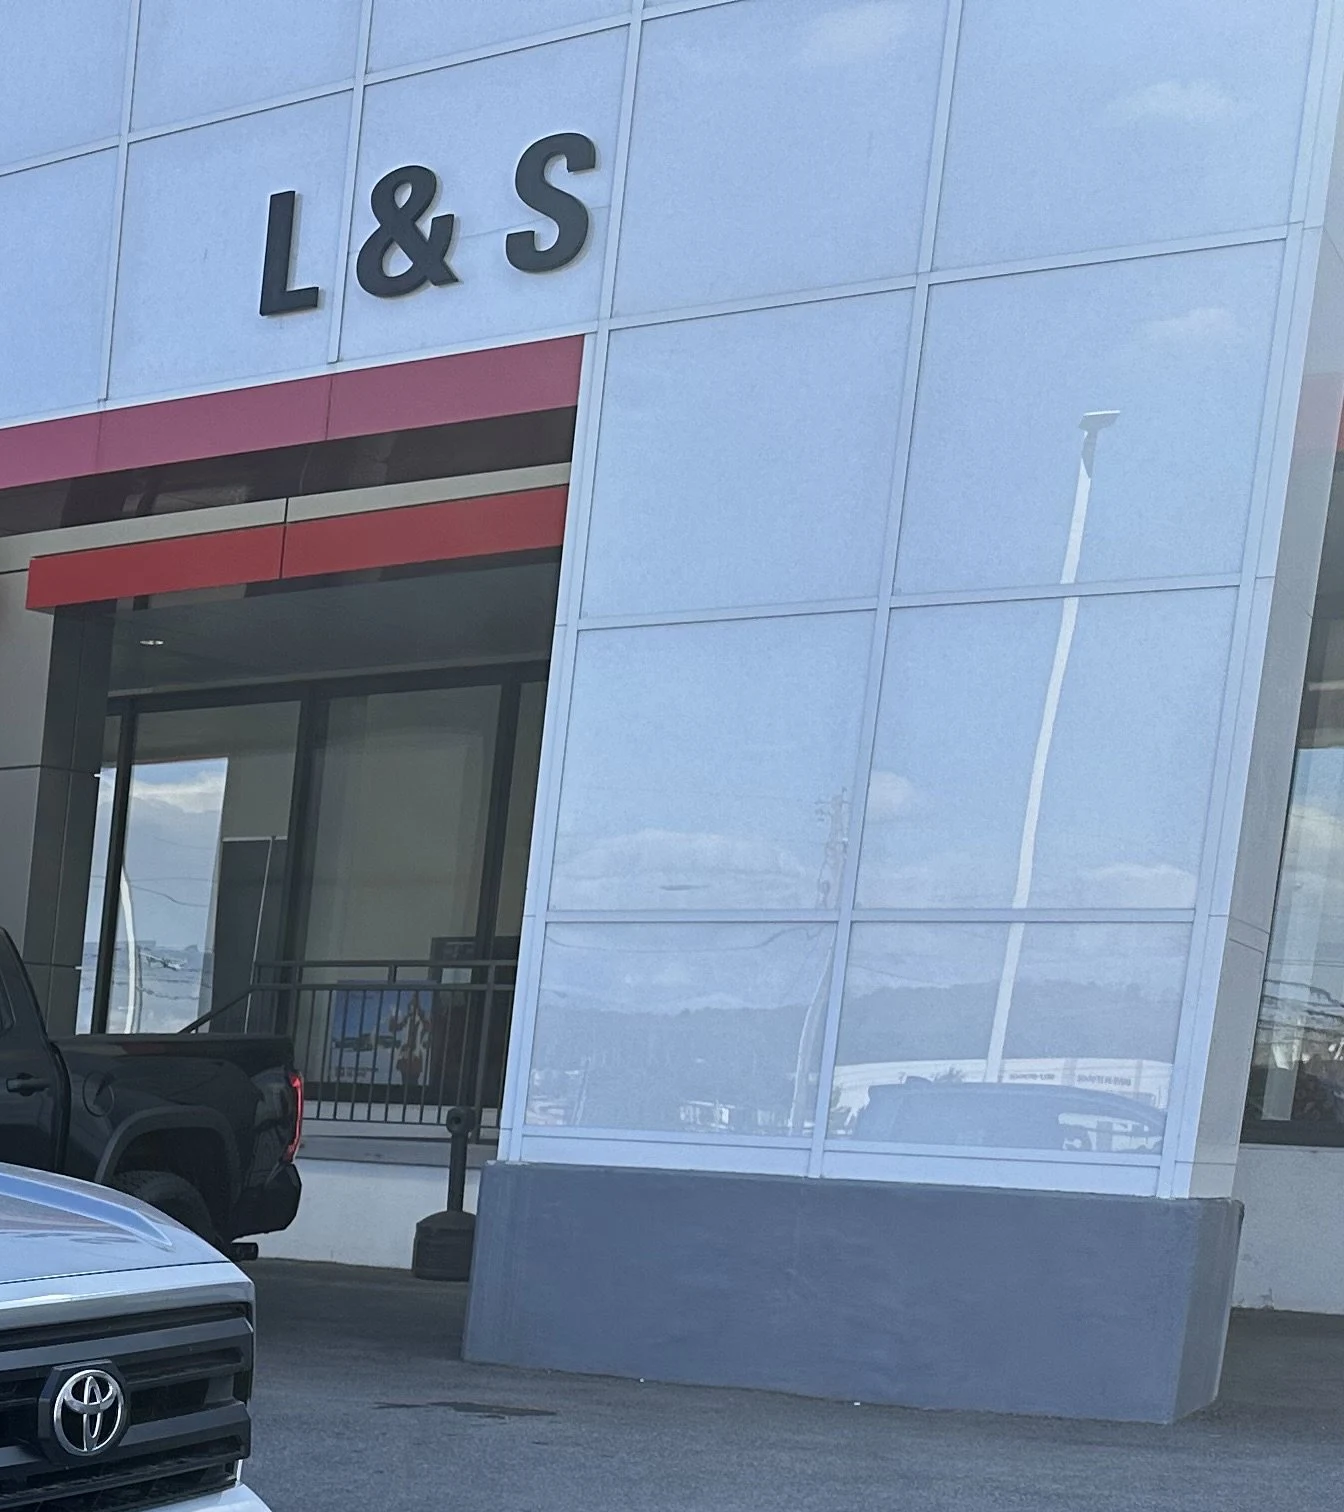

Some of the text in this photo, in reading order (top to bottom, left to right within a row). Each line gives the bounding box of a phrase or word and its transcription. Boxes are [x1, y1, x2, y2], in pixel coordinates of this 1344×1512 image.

[259, 132, 596, 316] L & S
